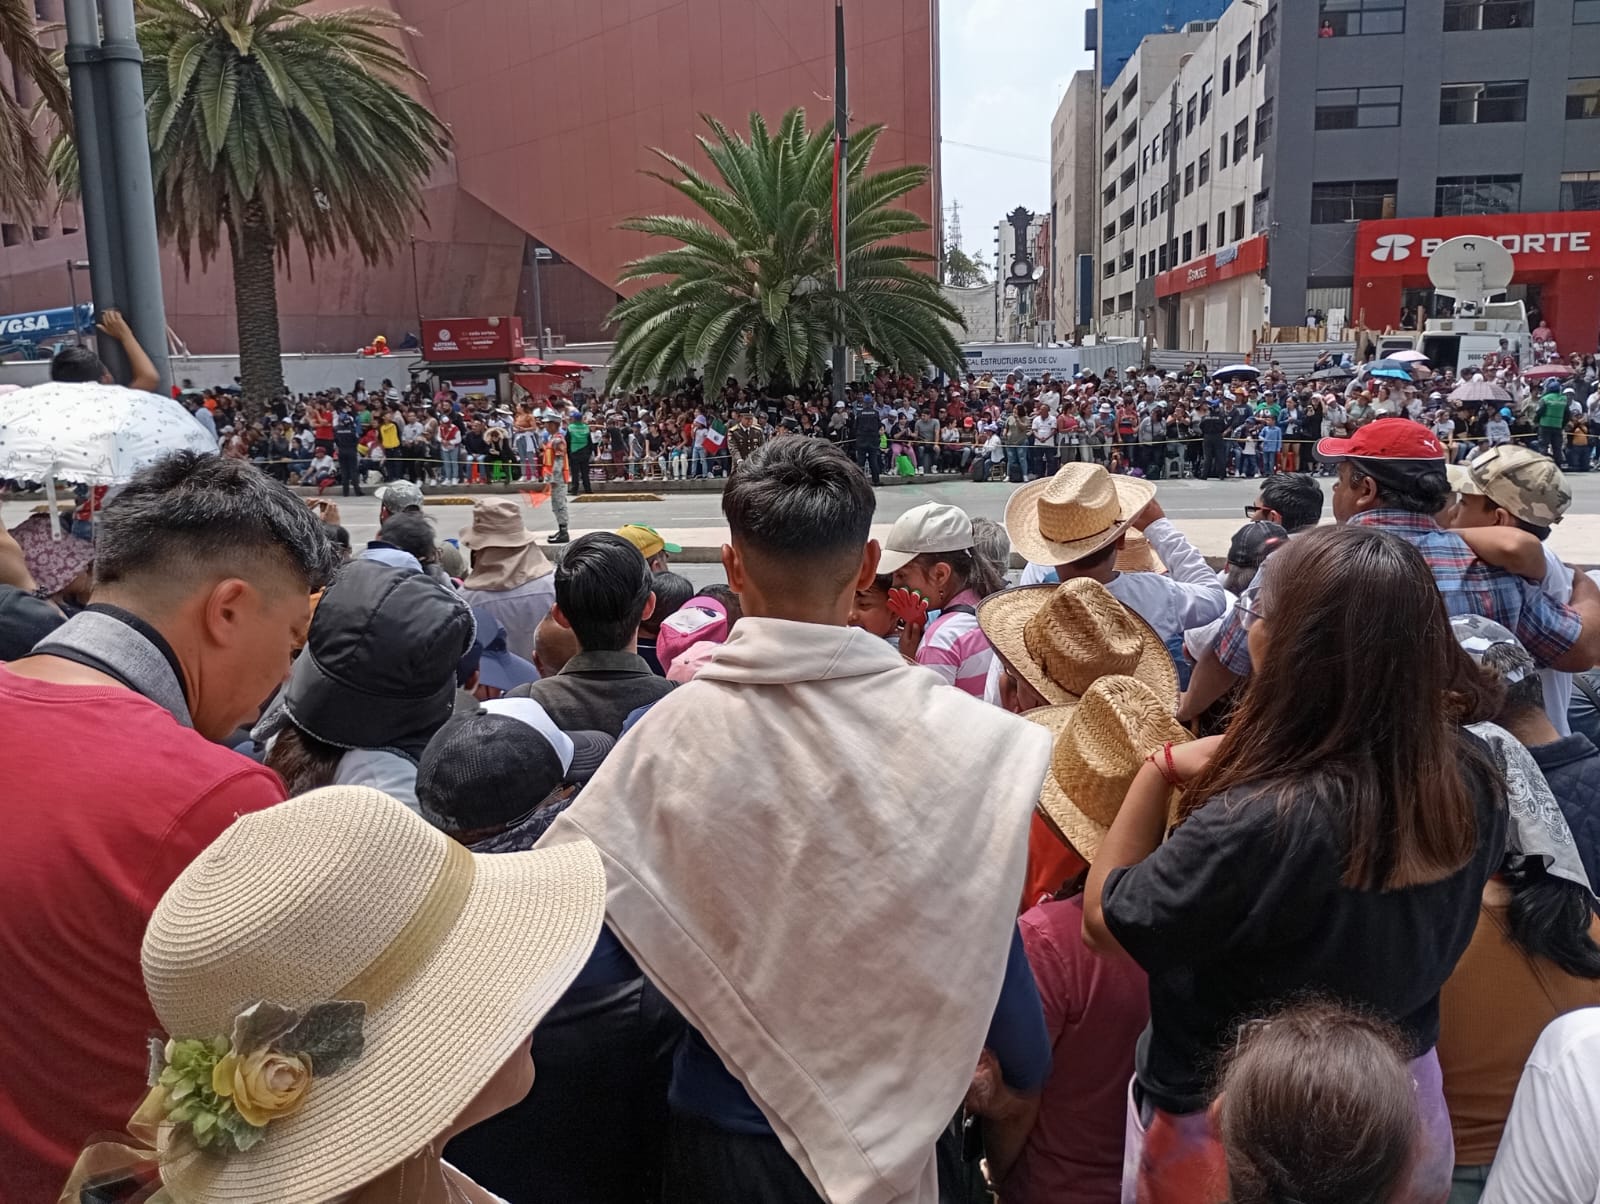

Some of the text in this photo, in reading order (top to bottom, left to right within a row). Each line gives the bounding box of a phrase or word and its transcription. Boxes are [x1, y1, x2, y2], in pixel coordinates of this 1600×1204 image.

[1421, 231, 1591, 258] BORTE
[980, 356, 1027, 366] ESTRUCTURAS
[1027, 356, 1037, 364] SA
[1038, 356, 1047, 364] DE
[1048, 356, 1058, 364] CV
